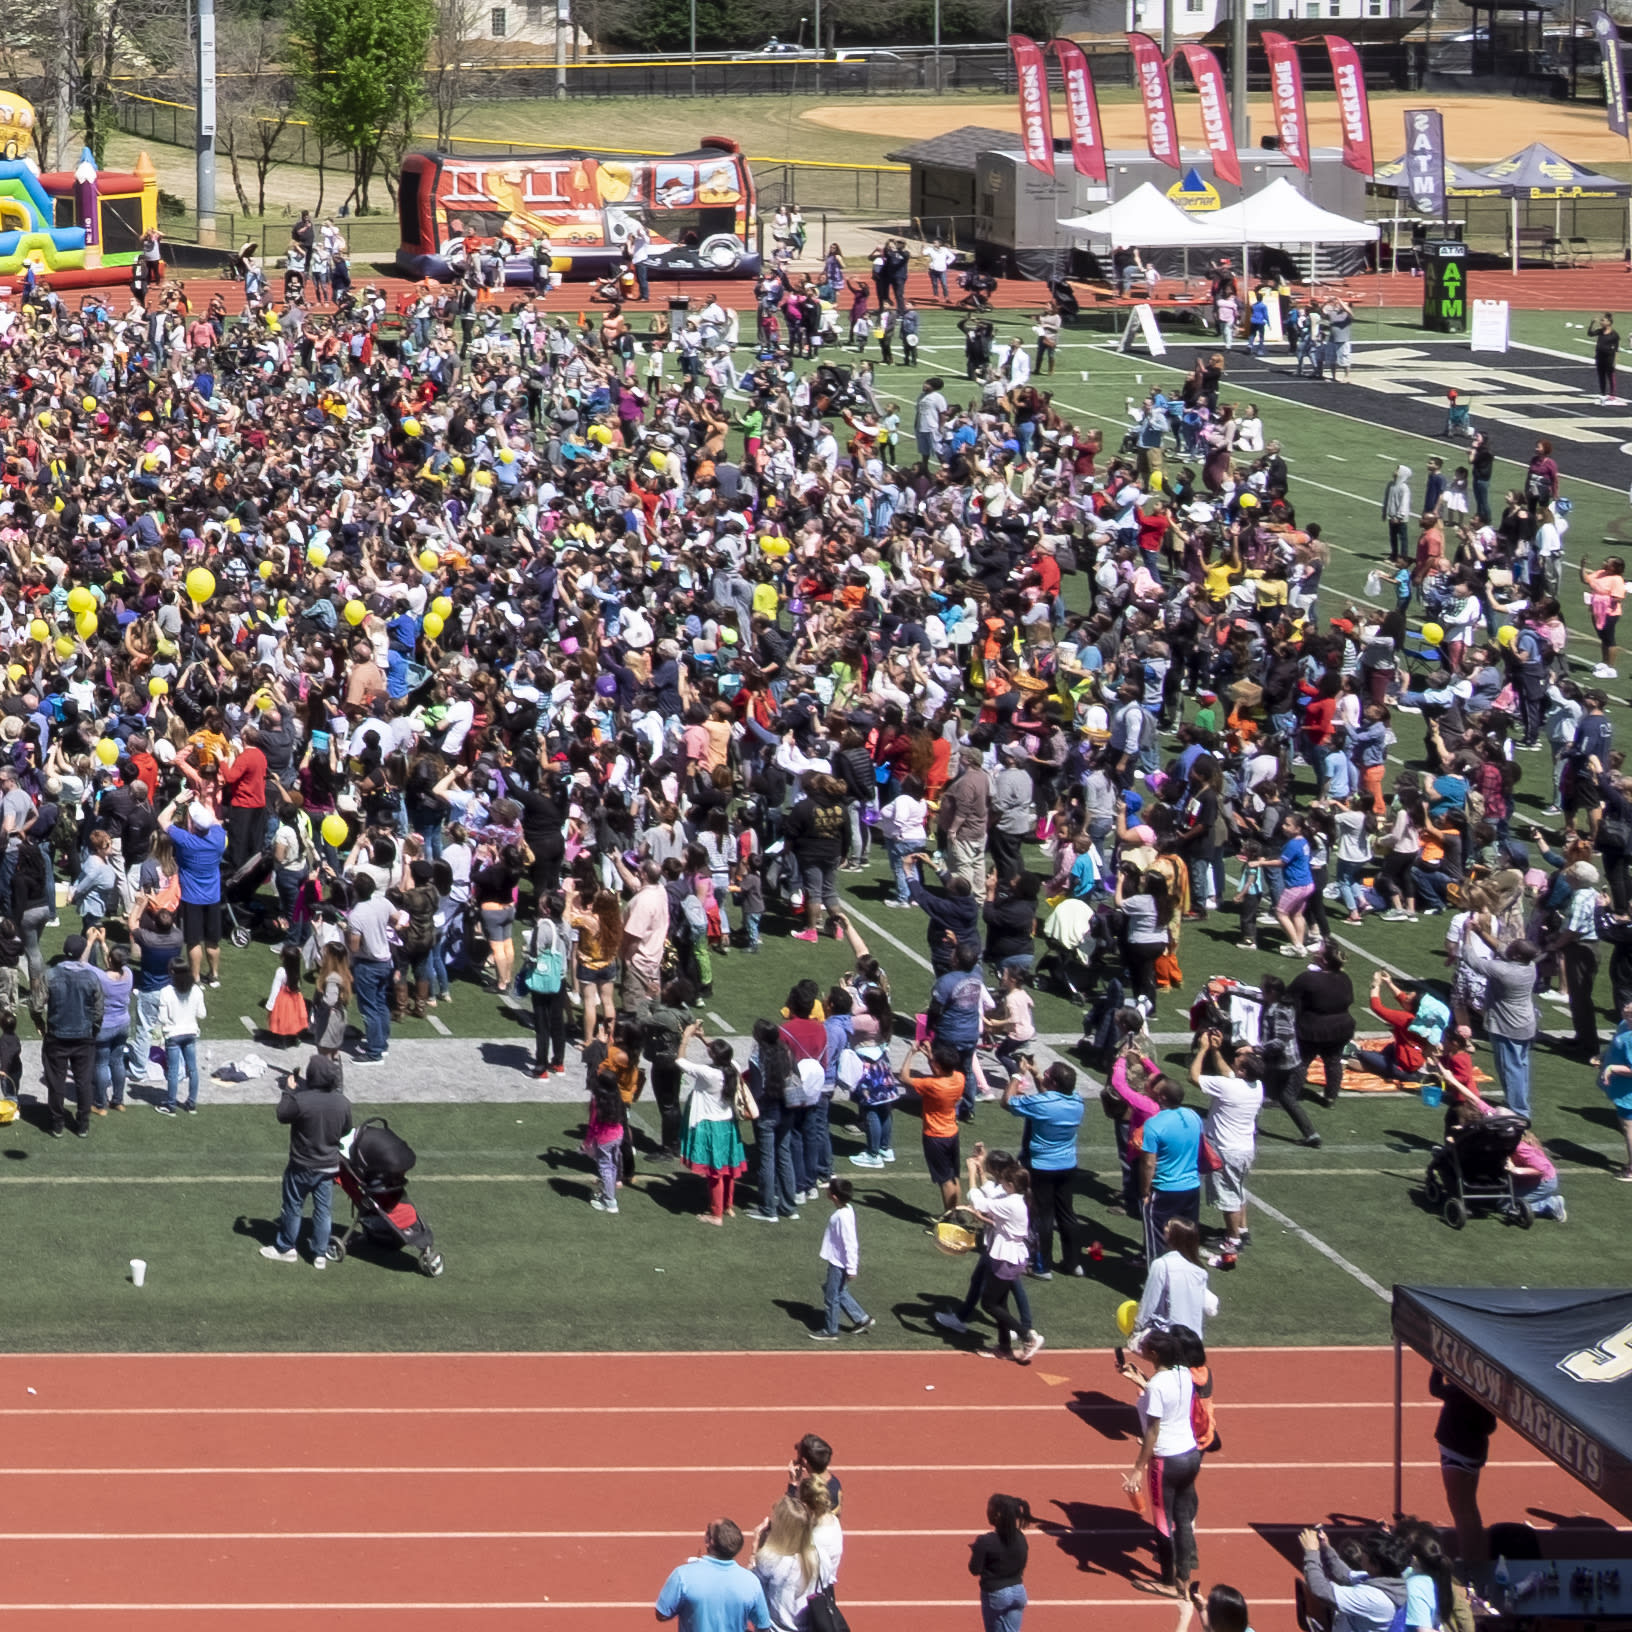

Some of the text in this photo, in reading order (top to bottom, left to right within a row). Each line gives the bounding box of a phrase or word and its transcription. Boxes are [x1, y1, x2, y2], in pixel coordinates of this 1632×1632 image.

[1439, 247, 1465, 255] ATM
[1441, 262, 1463, 318] ATM
[1430, 1323, 1601, 1482] YELLOW JACKETS
